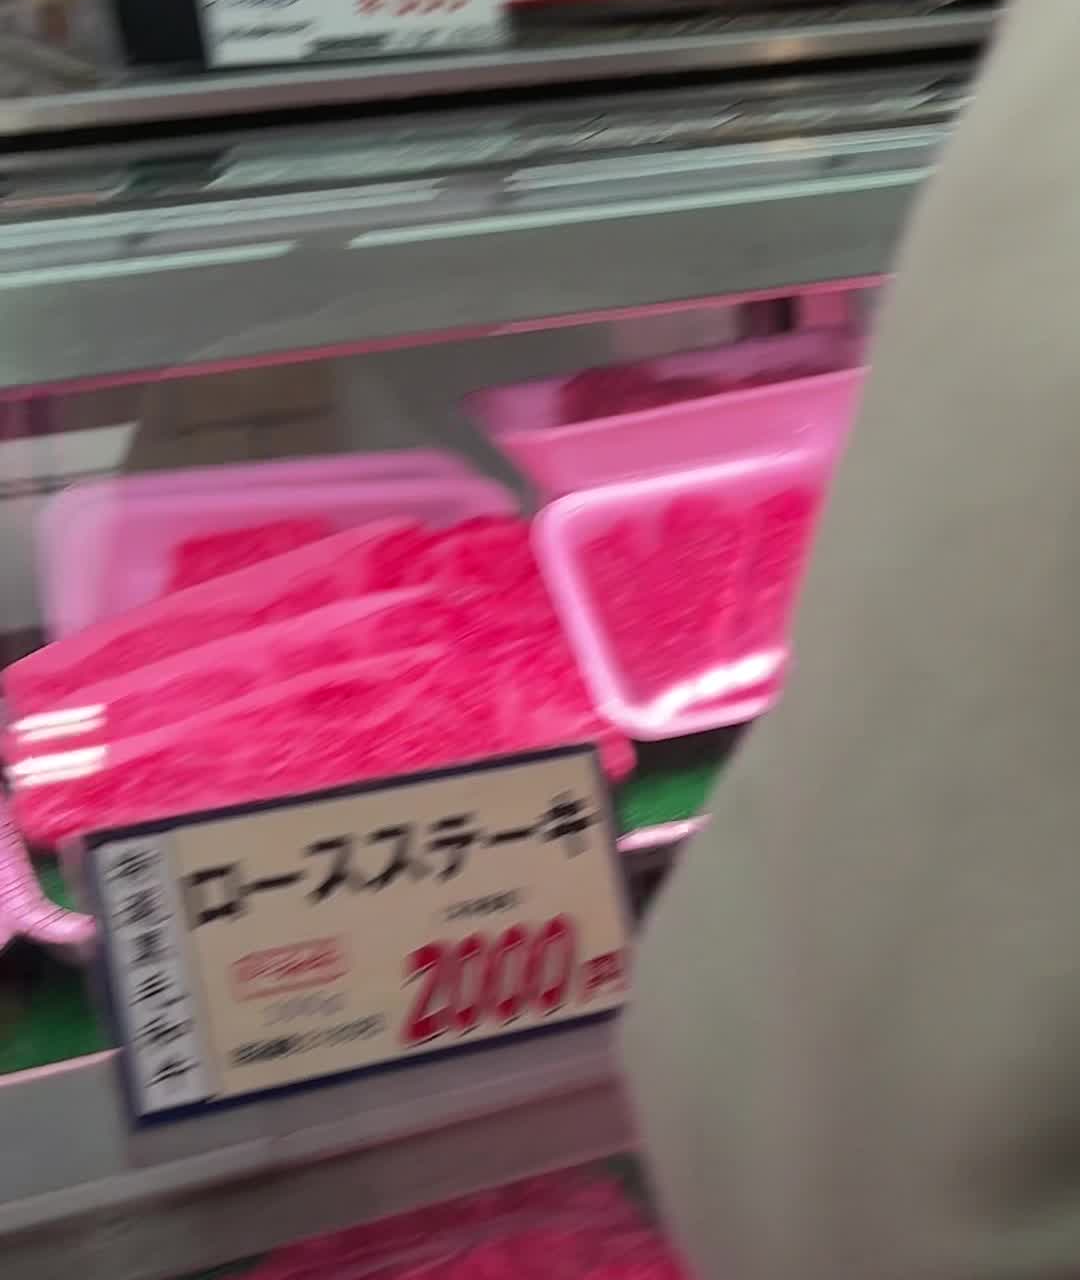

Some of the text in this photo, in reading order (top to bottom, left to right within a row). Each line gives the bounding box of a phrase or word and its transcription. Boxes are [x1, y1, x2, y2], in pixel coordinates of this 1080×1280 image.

[182, 789, 600, 931] ロースステーキ
[398, 912, 628, 1049] 2000円
